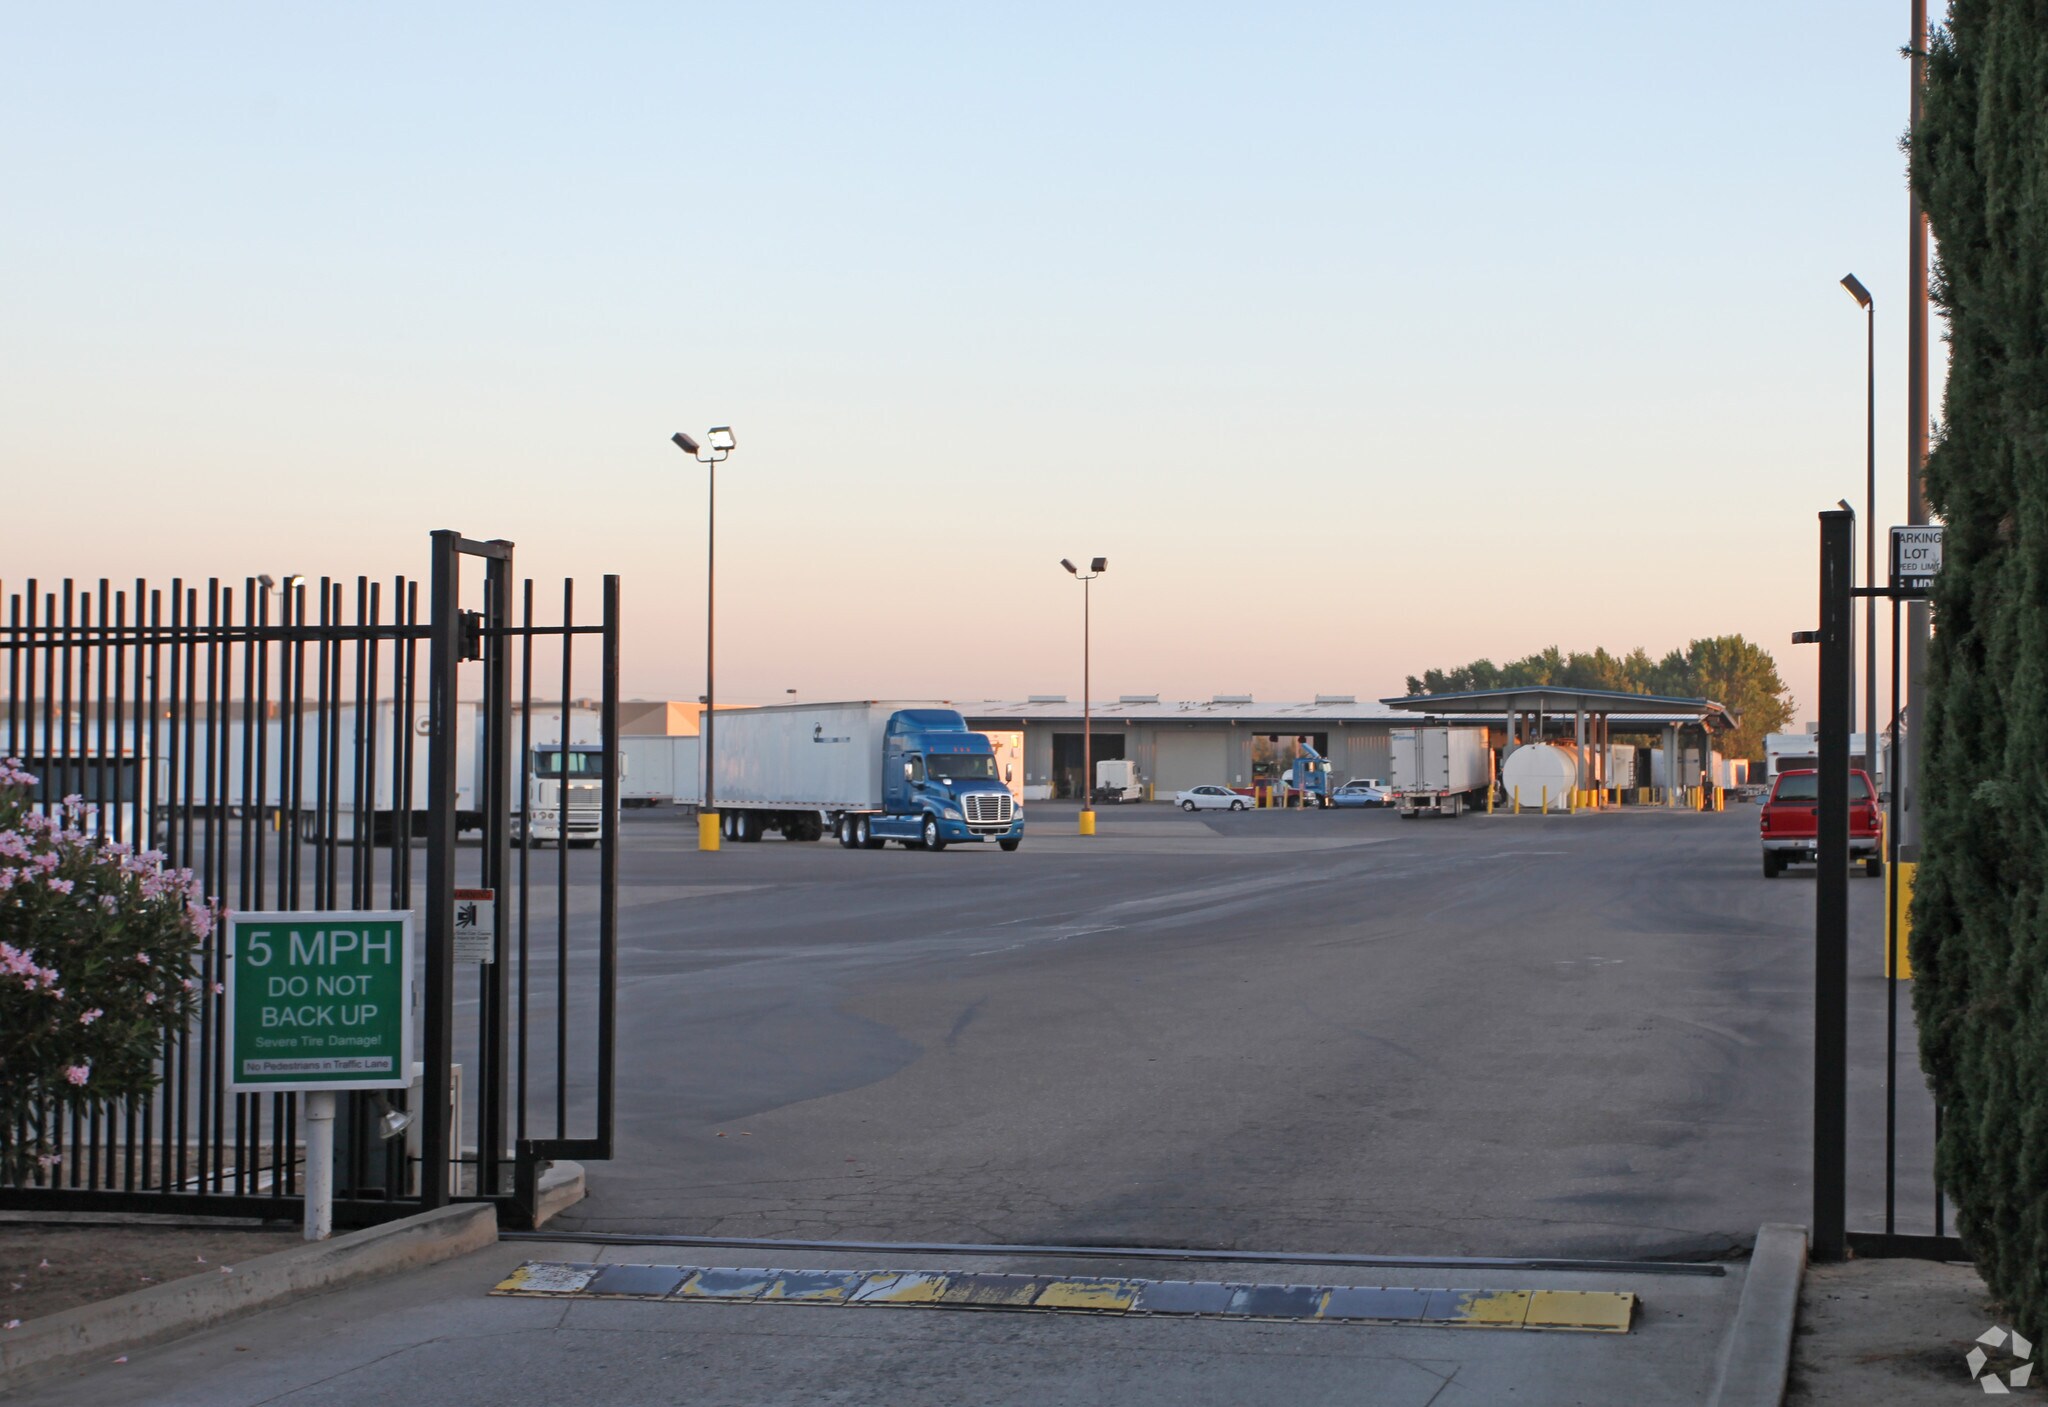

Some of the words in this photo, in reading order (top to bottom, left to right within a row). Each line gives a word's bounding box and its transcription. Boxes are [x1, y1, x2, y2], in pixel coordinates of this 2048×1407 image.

[1900, 533, 1942, 543] ARKING
[1904, 548, 1929, 559] LOT
[1900, 563, 1917, 571] EED
[247, 931, 272, 967] 5
[289, 930, 391, 966] MPH
[268, 976, 308, 997] DO
[316, 975, 373, 996] NOT
[262, 1005, 335, 1027] BACK
[341, 1004, 378, 1025] UP
[255, 1036, 298, 1048] Severe
[301, 1035, 324, 1047] Tire
[328, 1034, 382, 1048] Damage!
[246, 1062, 261, 1071] No
[263, 1060, 320, 1071] Pedestrians
[323, 1060, 332, 1069] in
[334, 1059, 362, 1069] Traffic
[364, 1059, 389, 1069] Lane
